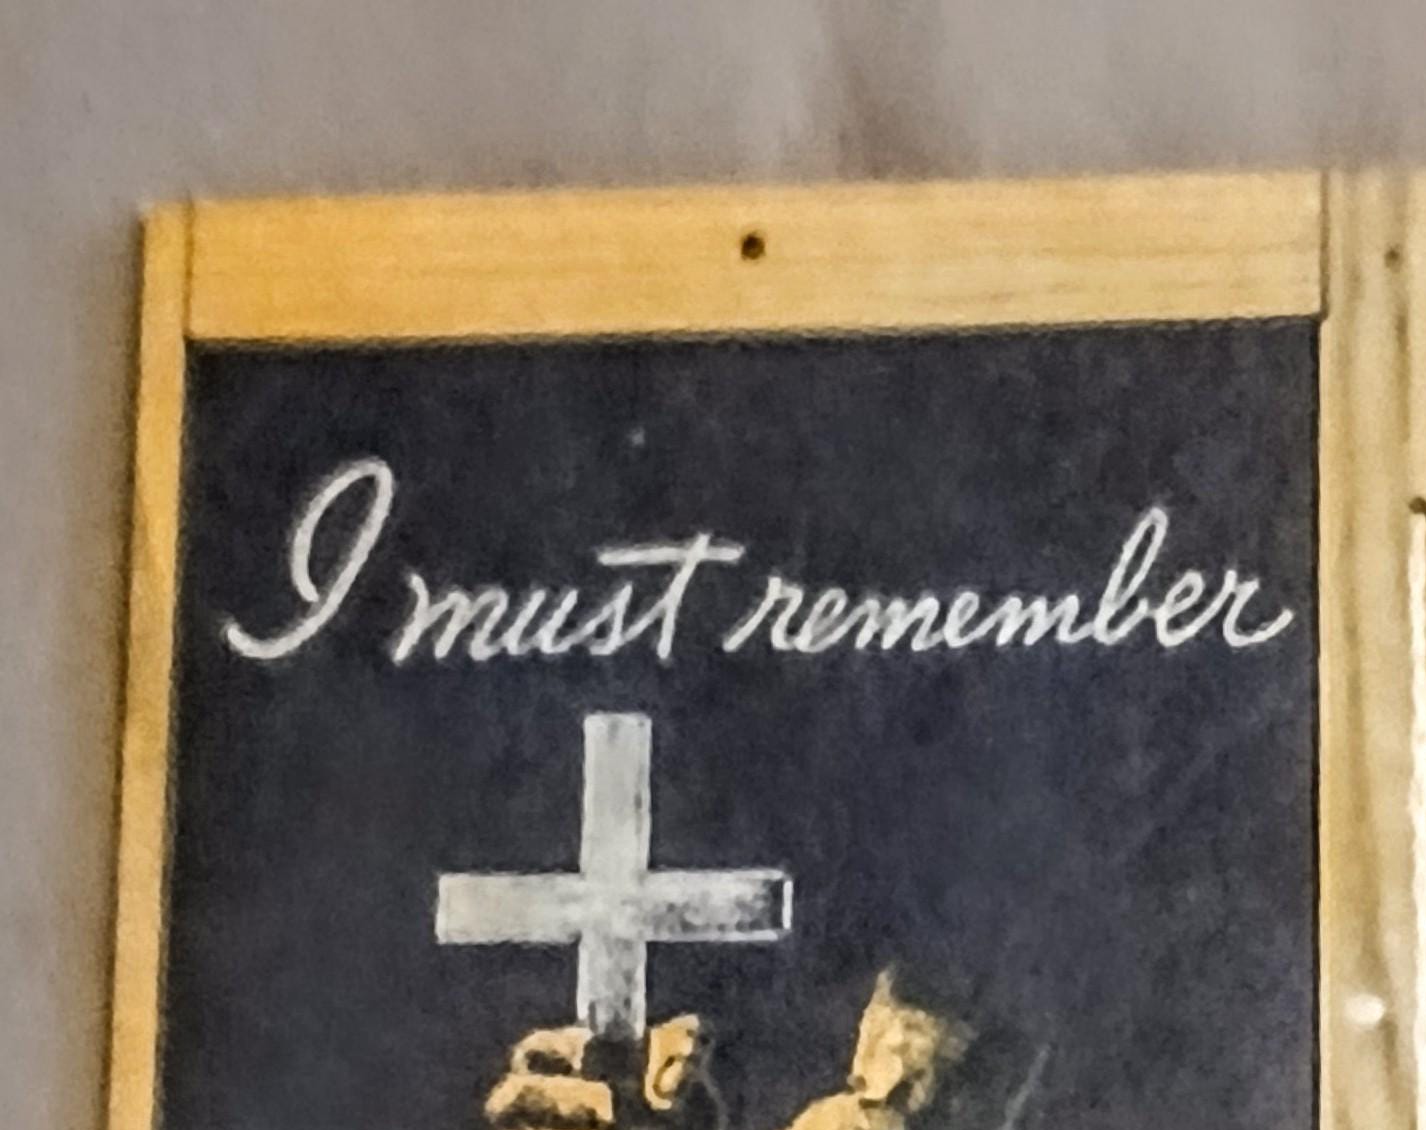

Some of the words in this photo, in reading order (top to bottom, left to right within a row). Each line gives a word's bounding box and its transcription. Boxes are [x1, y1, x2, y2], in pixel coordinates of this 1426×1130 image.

[226, 455, 396, 663] I
[392, 534, 745, 663] must
[722, 507, 1294, 653] remember
